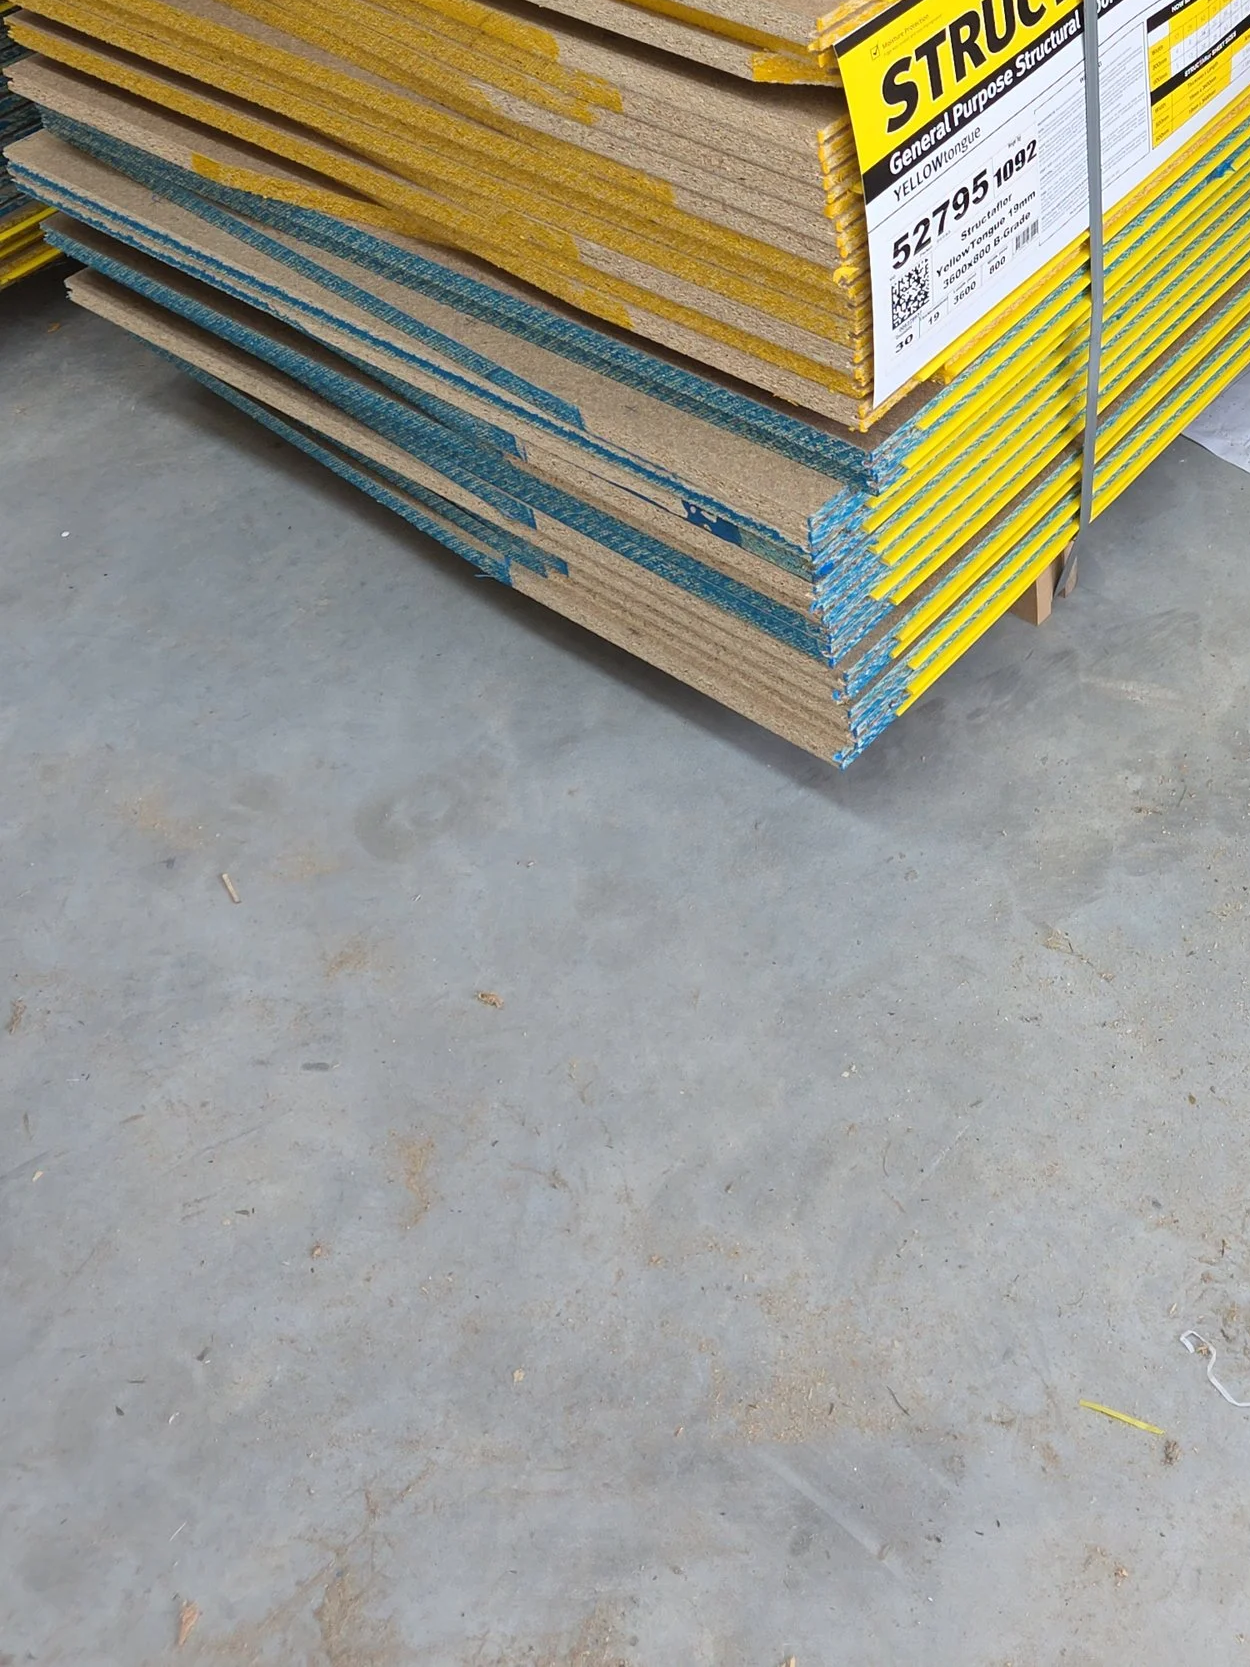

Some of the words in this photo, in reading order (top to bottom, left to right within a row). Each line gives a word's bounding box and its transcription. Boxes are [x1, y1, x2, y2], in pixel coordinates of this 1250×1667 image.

[889, 112, 951, 175] General
[953, 69, 1013, 126] Purpose
[1015, 8, 1081, 77] Structural
[892, 168, 989, 270] 52795
[993, 139, 1038, 188] 1092
[893, 127, 981, 202] YELLOWtongue
[936, 217, 1006, 278] YellowTongue
[1008, 191, 1036, 216] 19mm
[943, 244, 990, 290] 3600x800
[994, 211, 1031, 247] B-Grade
[960, 194, 1013, 241] Structaflor
[895, 334, 914, 354] 30
[928, 312, 940, 325] 19
[954, 281, 976, 305] 3600
[989, 256, 1006, 274] 800
